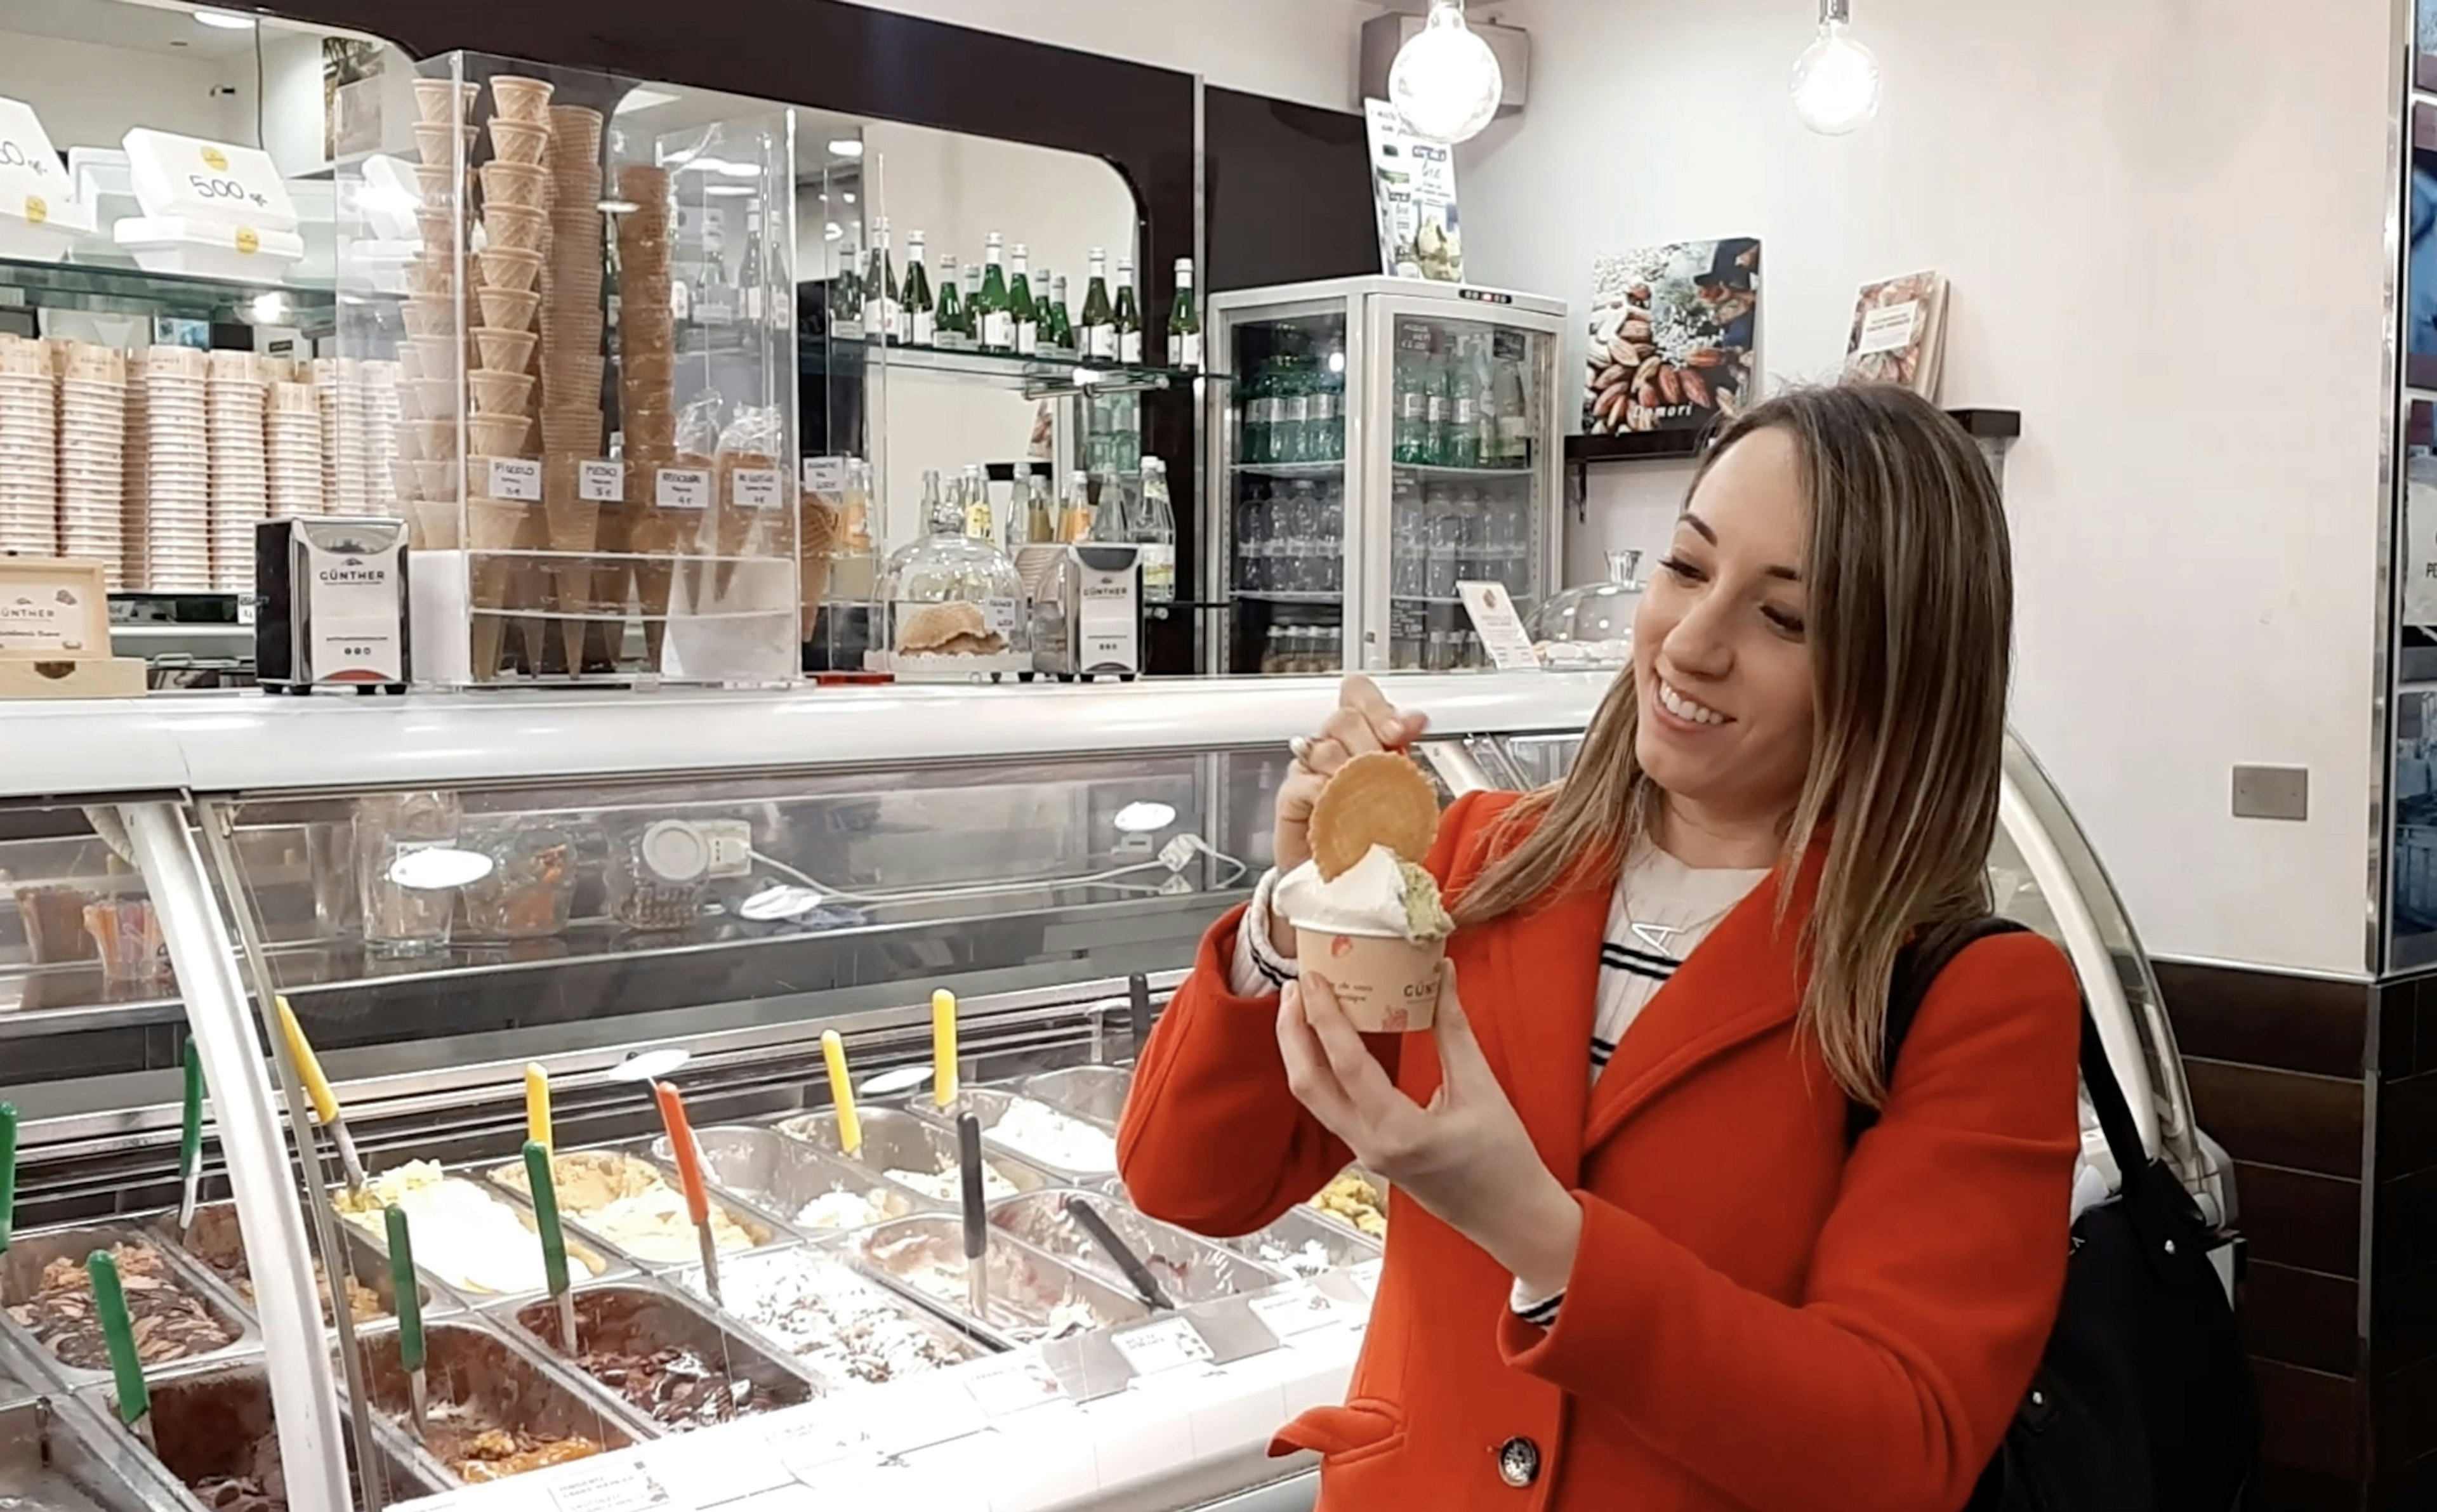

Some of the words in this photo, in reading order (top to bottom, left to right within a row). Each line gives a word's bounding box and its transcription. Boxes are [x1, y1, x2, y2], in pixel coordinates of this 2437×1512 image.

[189, 174, 244, 200] 500
[494, 463, 535, 476] PICCOLO
[319, 569, 385, 581] GÜNTHER
[1083, 587, 1128, 596] GÜNTHER
[0, 607, 55, 617] ÜNTHER
